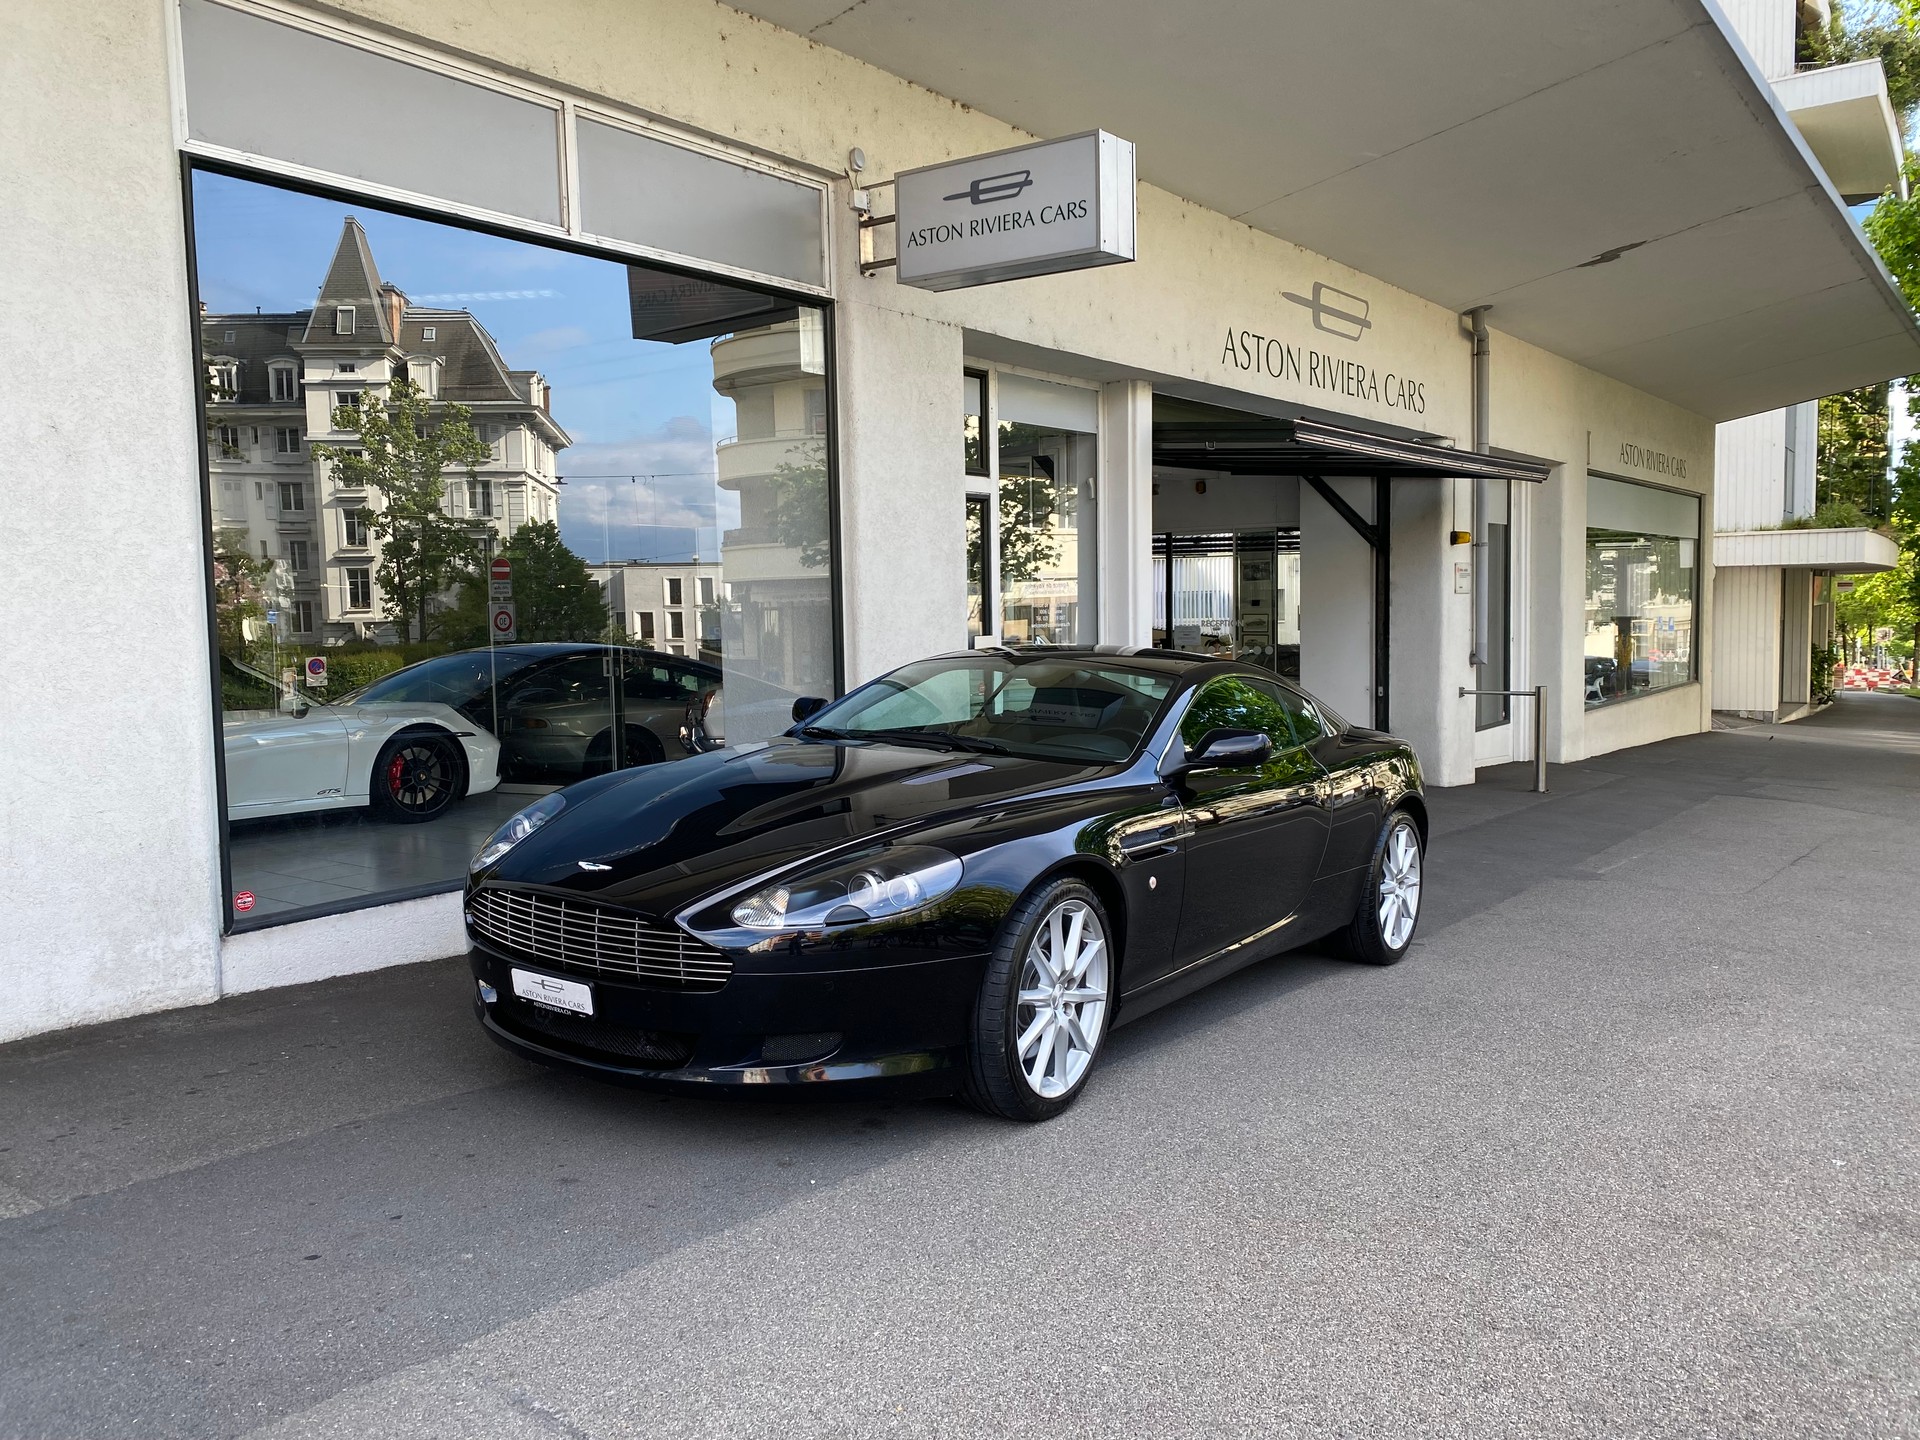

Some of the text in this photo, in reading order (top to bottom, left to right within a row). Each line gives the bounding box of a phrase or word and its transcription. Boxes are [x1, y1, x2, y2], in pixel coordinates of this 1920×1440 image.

[907, 199, 1088, 248] ASTON RIVIERA CARS
[1221, 326, 1426, 414] ASTON RIVIERA CARS
[1619, 442, 1687, 479] ASTON RIVIERA CARS
[1201, 619, 1245, 627] RECEPTION
[317, 787, 341, 796] GTS
[521, 988, 585, 1011] ASTON RIVIERA CARS
